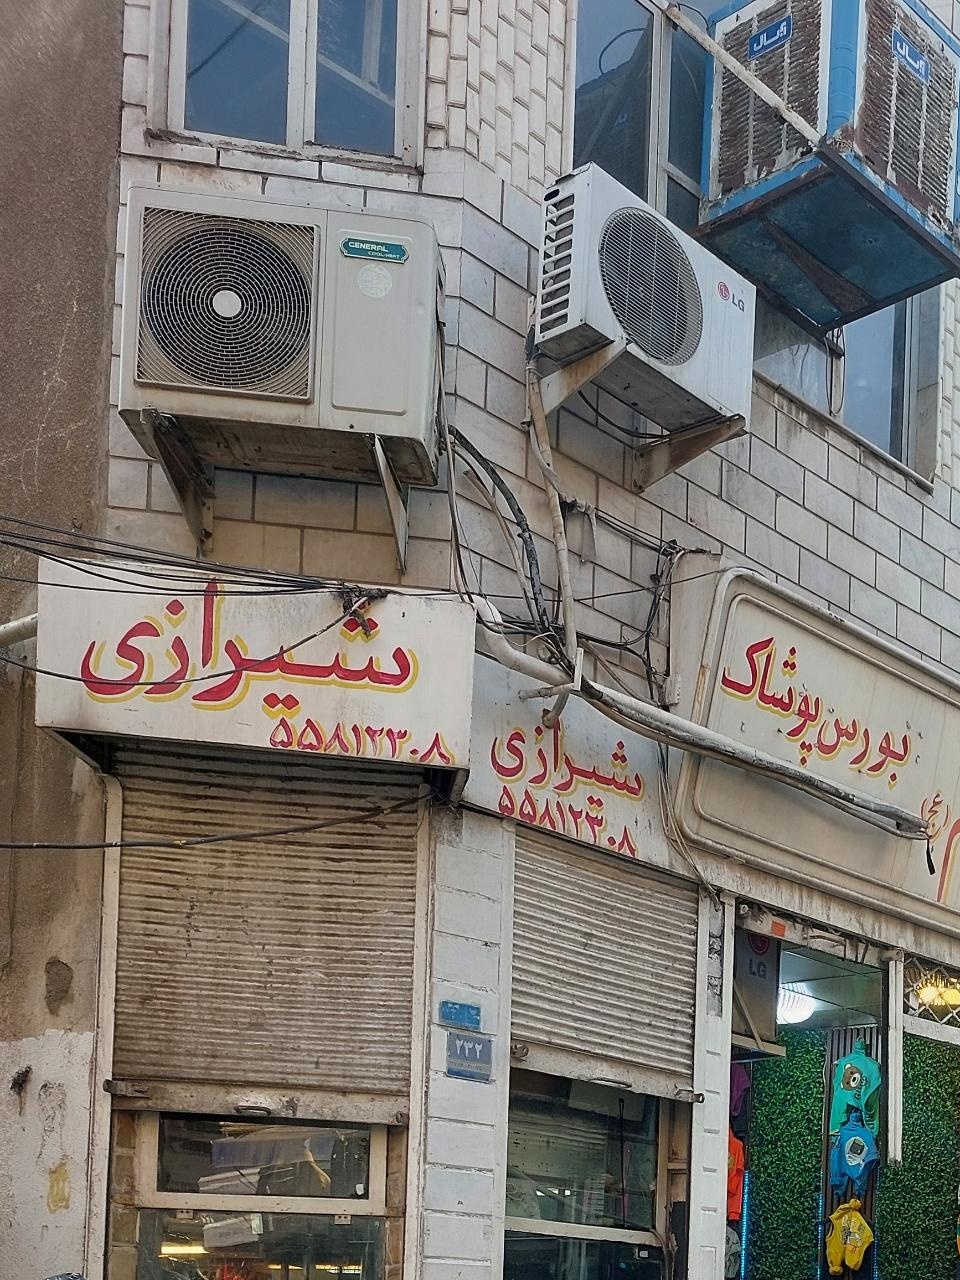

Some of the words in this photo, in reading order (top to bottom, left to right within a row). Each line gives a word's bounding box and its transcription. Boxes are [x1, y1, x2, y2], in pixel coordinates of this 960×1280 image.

[348, 241, 389, 253] GENERAL
[732, 293, 745, 313] LG
[80, 576, 417, 714] شیرازی
[721, 637, 821, 766] پوشاک
[490, 717, 644, 808] شیرازی
[816, 717, 911, 784] بورس
[748, 958, 767, 980] LG
[455, 1039, 483, 1060] ۲۳۲
